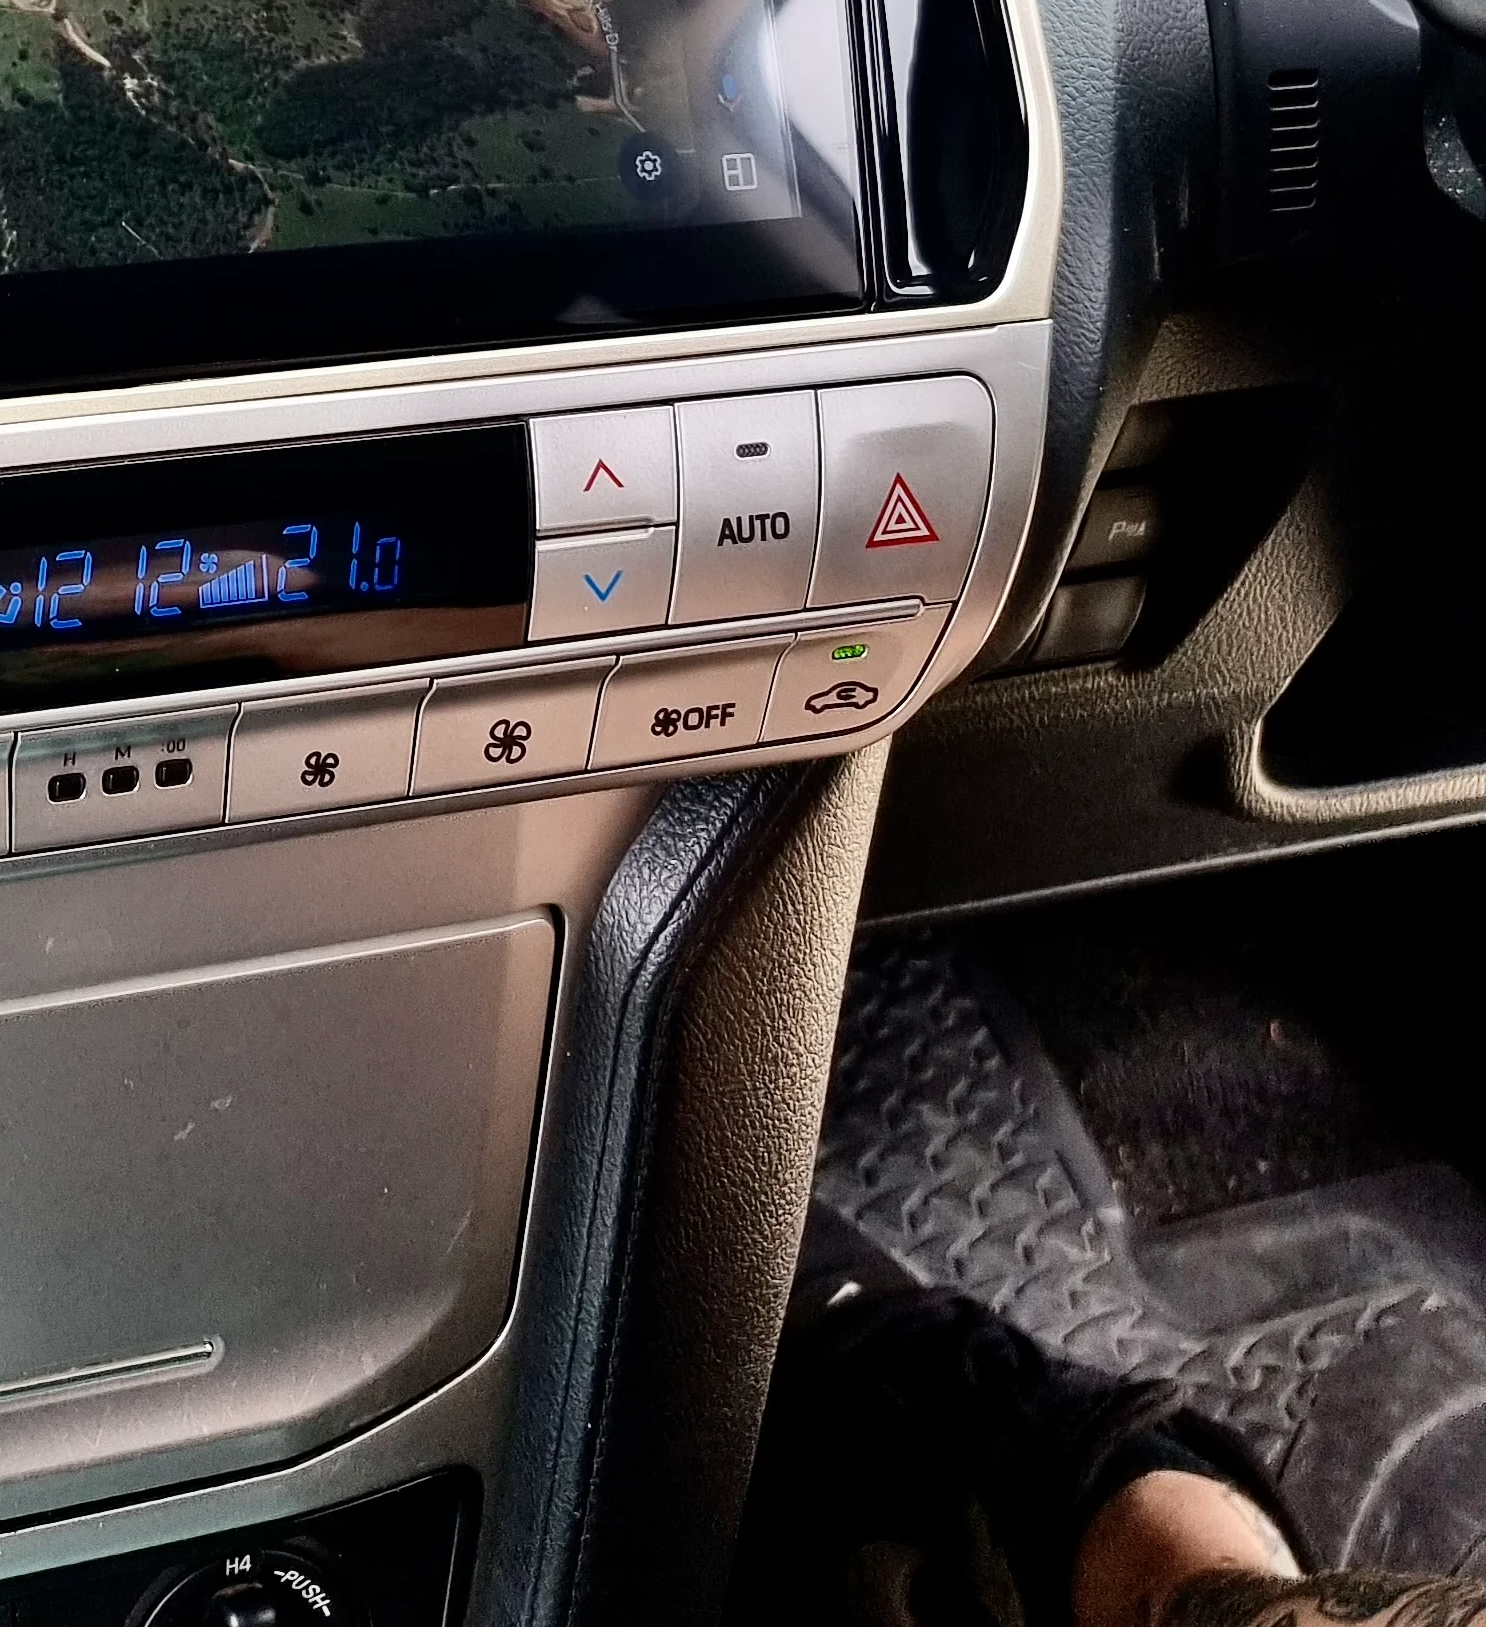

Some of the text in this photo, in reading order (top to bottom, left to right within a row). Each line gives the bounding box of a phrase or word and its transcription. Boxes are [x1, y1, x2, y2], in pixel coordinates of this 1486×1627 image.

[716, 511, 791, 547] AUTO
[276, 521, 402, 603] 21.0
[681, 702, 737, 733] OFF
[62, 751, 77, 767] H
[114, 745, 132, 761] M
[225, 1554, 252, 1576] H4
